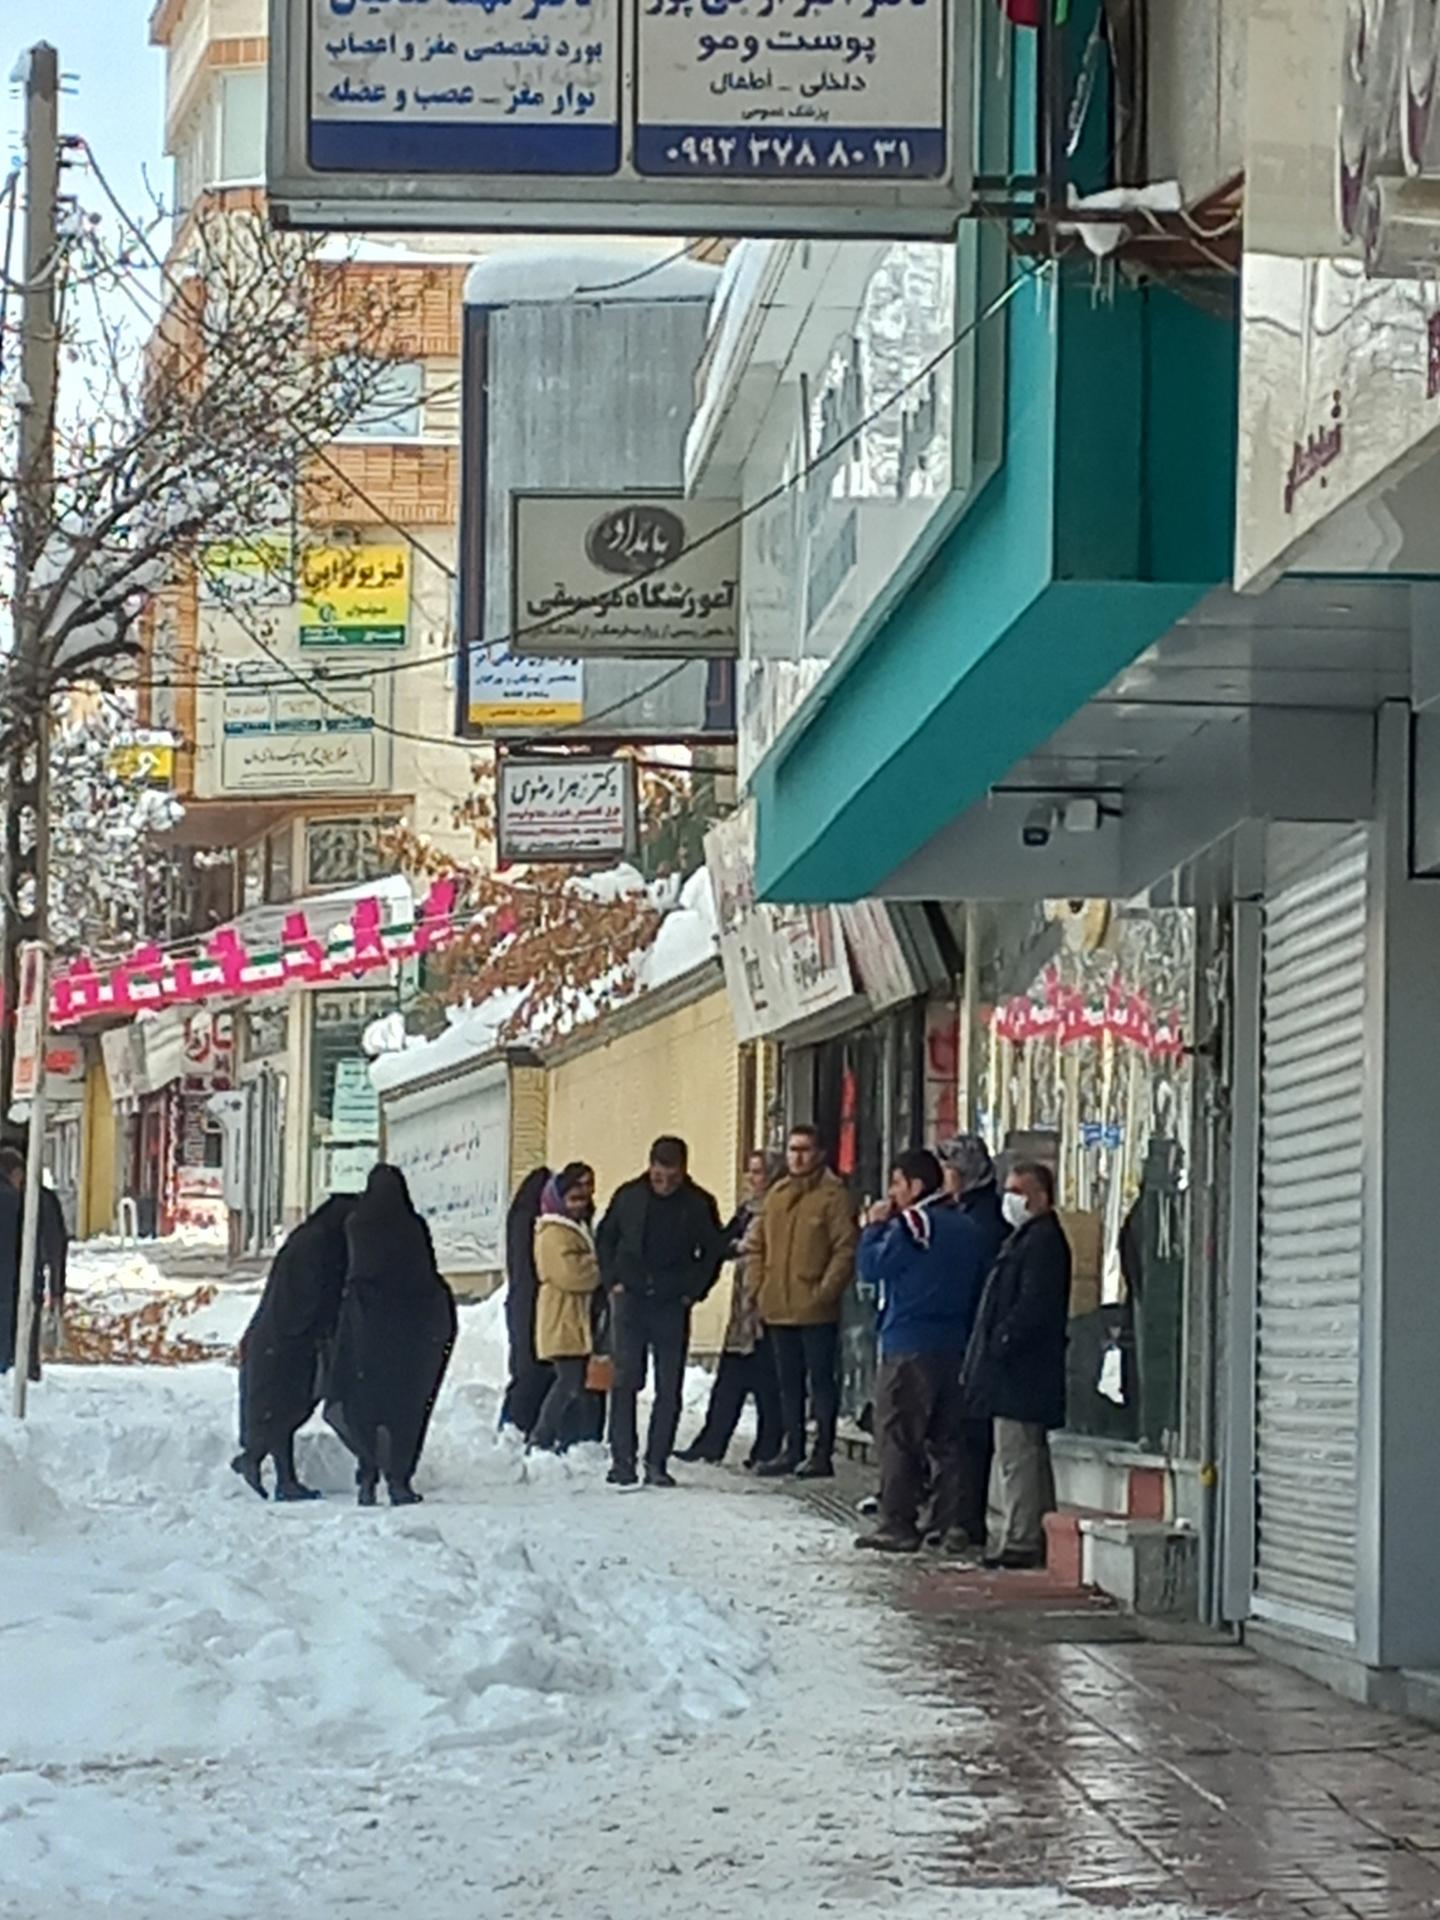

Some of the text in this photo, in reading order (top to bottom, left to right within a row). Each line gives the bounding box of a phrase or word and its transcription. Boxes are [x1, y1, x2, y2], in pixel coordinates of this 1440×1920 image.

[324, 31, 603, 64] بورد تخصصی مغز و اعصاب
[765, 30, 877, 63] پوست
[328, 76, 596, 116] نوار مغز عصب و عضله
[709, 68, 867, 97] داخلی اطفال
[787, 104, 830, 122] پزشک
[302, 554, 405, 594] فیزیوتراپی
[526, 579, 739, 618] آموزشگاه موسیقی
[510, 774, 555, 805] رضوی
[586, 766, 618, 804] دکتر
